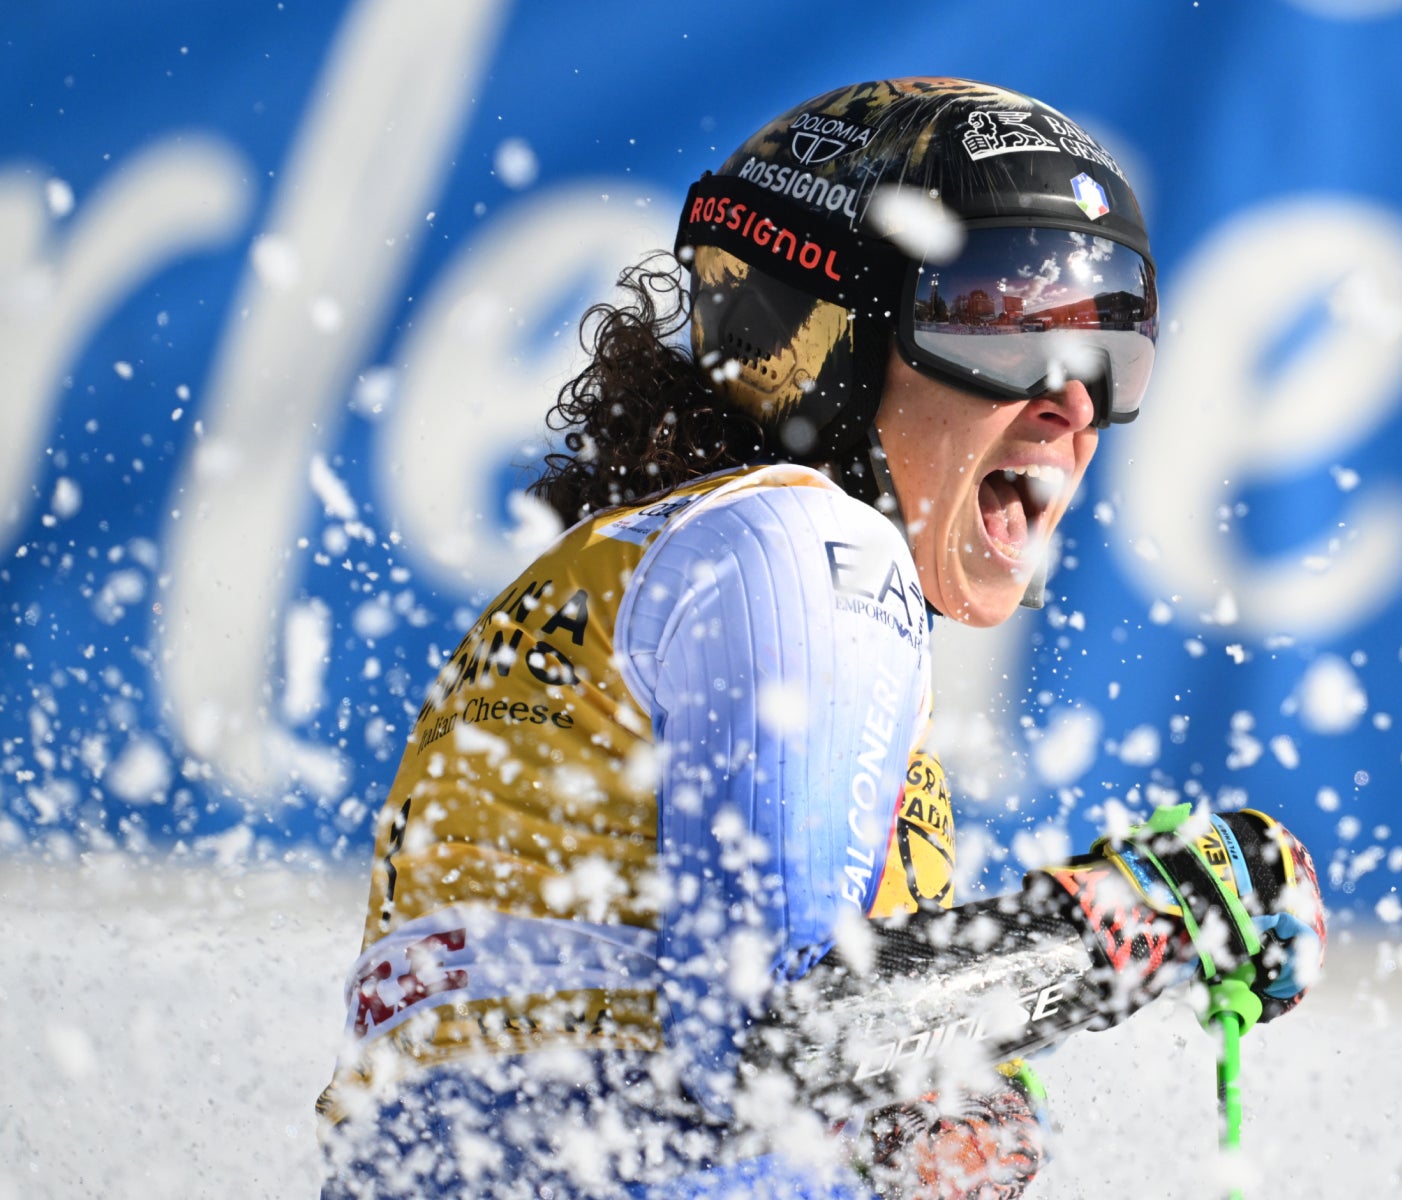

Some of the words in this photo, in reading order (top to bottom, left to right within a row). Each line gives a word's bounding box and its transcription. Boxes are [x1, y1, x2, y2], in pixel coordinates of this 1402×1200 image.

[790, 113, 872, 148] DOLOMIA
[738, 159, 857, 219] ROSSIGNOL
[689, 196, 842, 282] ROSSIGNOL
[462, 696, 574, 729] Cheese
[906, 760, 949, 807] GRA
